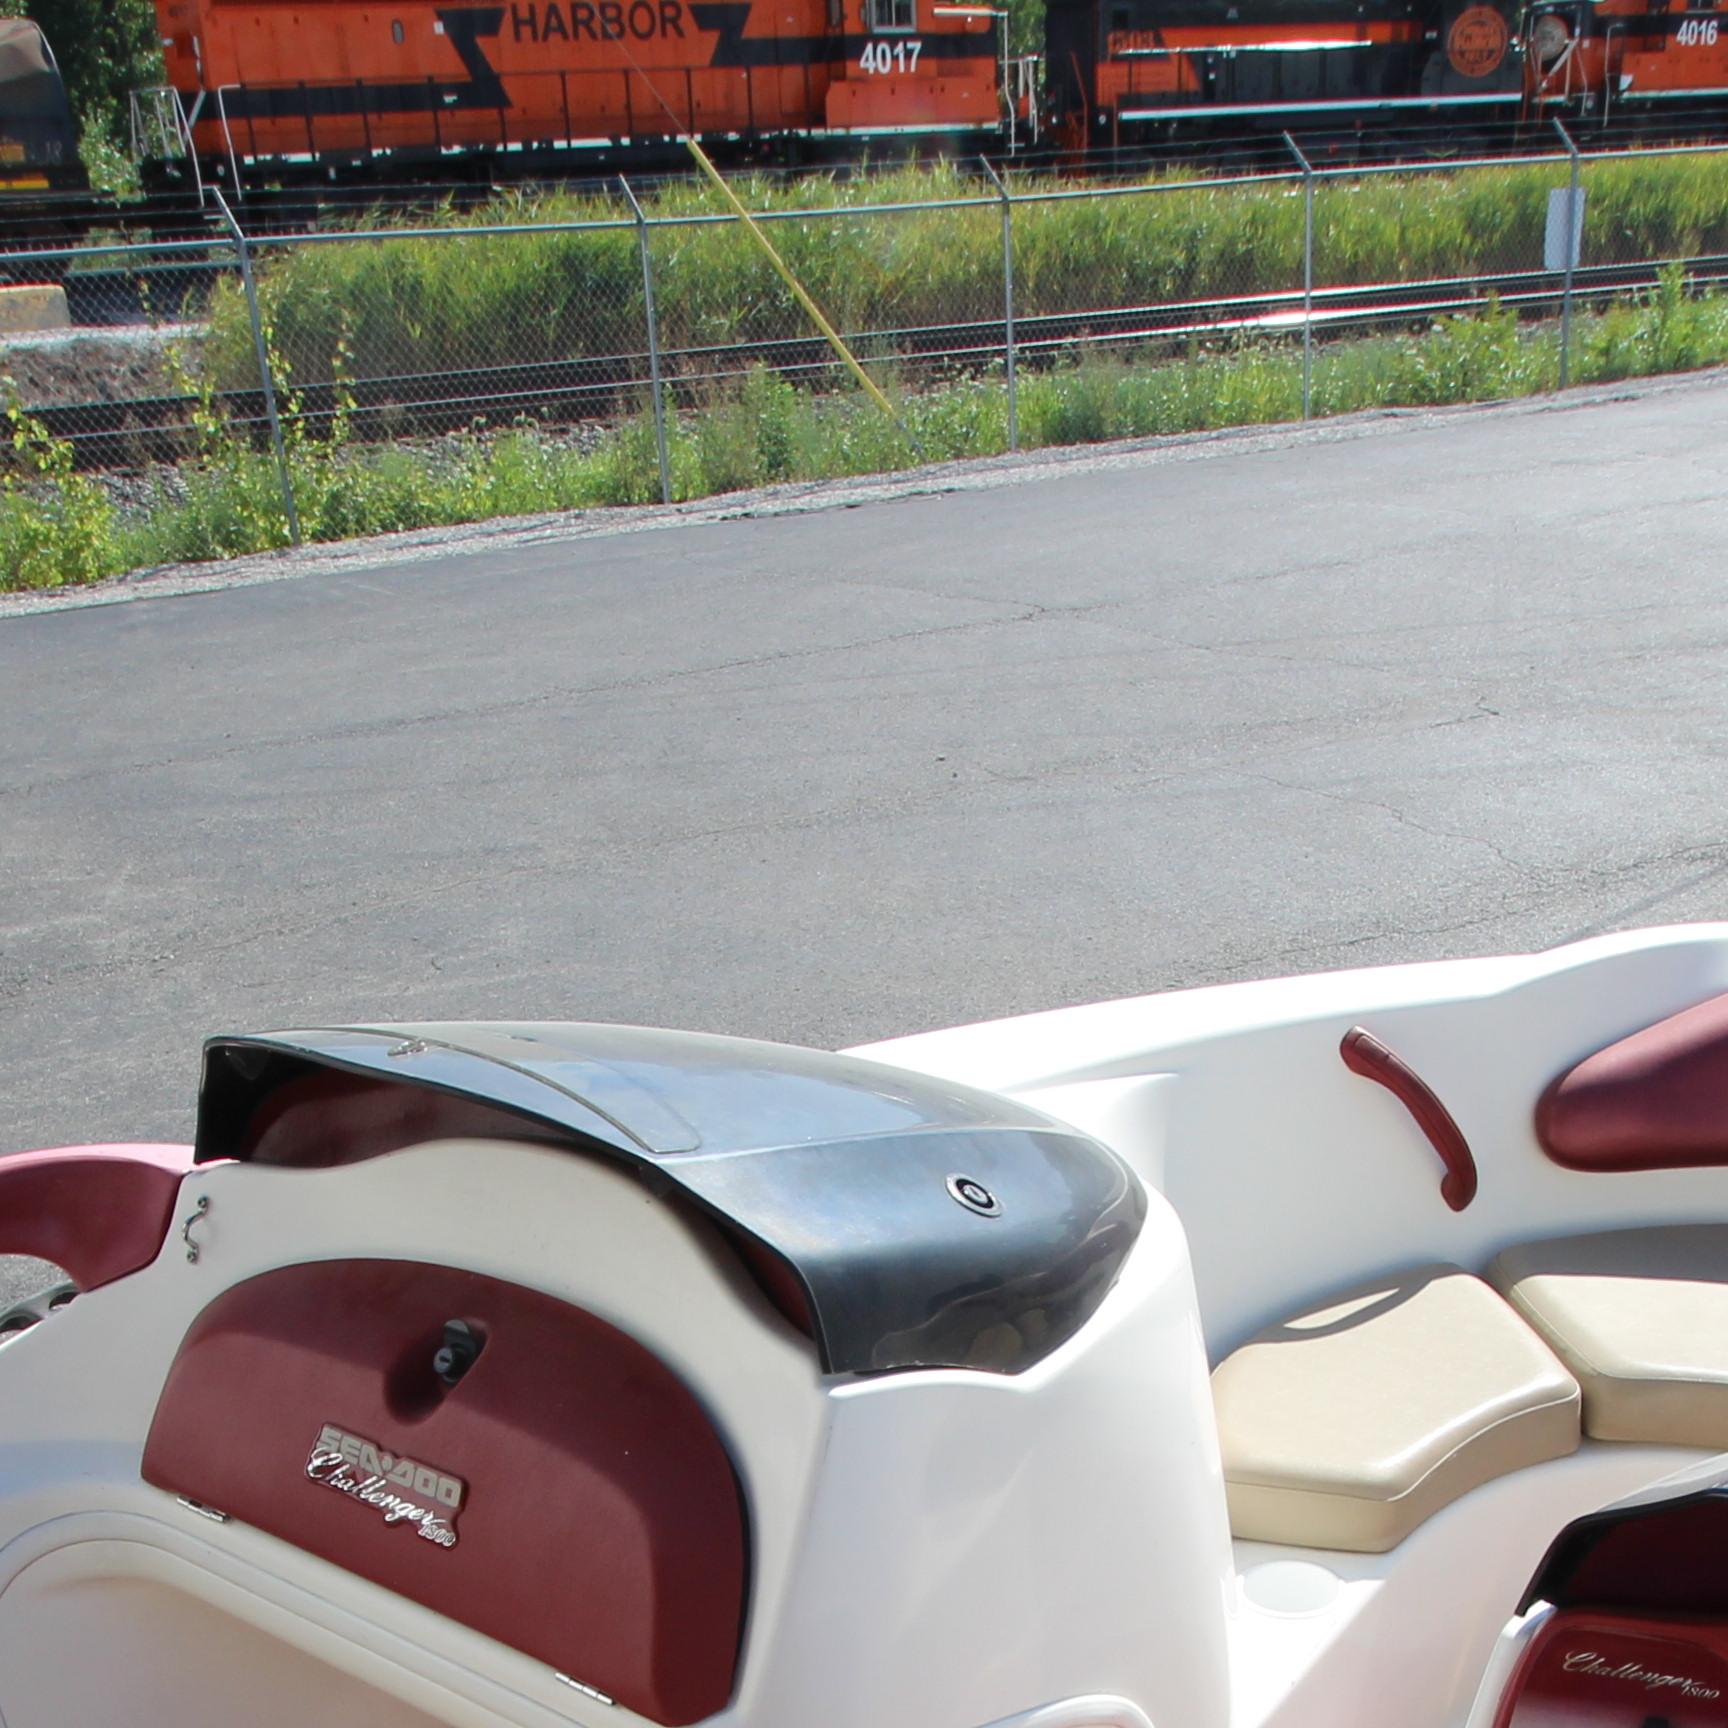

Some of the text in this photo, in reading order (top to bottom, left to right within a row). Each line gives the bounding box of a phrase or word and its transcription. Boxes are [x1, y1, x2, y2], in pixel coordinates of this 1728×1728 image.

[512, 0, 685, 42] HARBOR
[1676, 20, 1719, 46] 4016
[859, 41, 922, 74] 4017
[308, 1447, 447, 1527] Challenger
[1562, 1651, 1721, 1699] Challenger 1800
